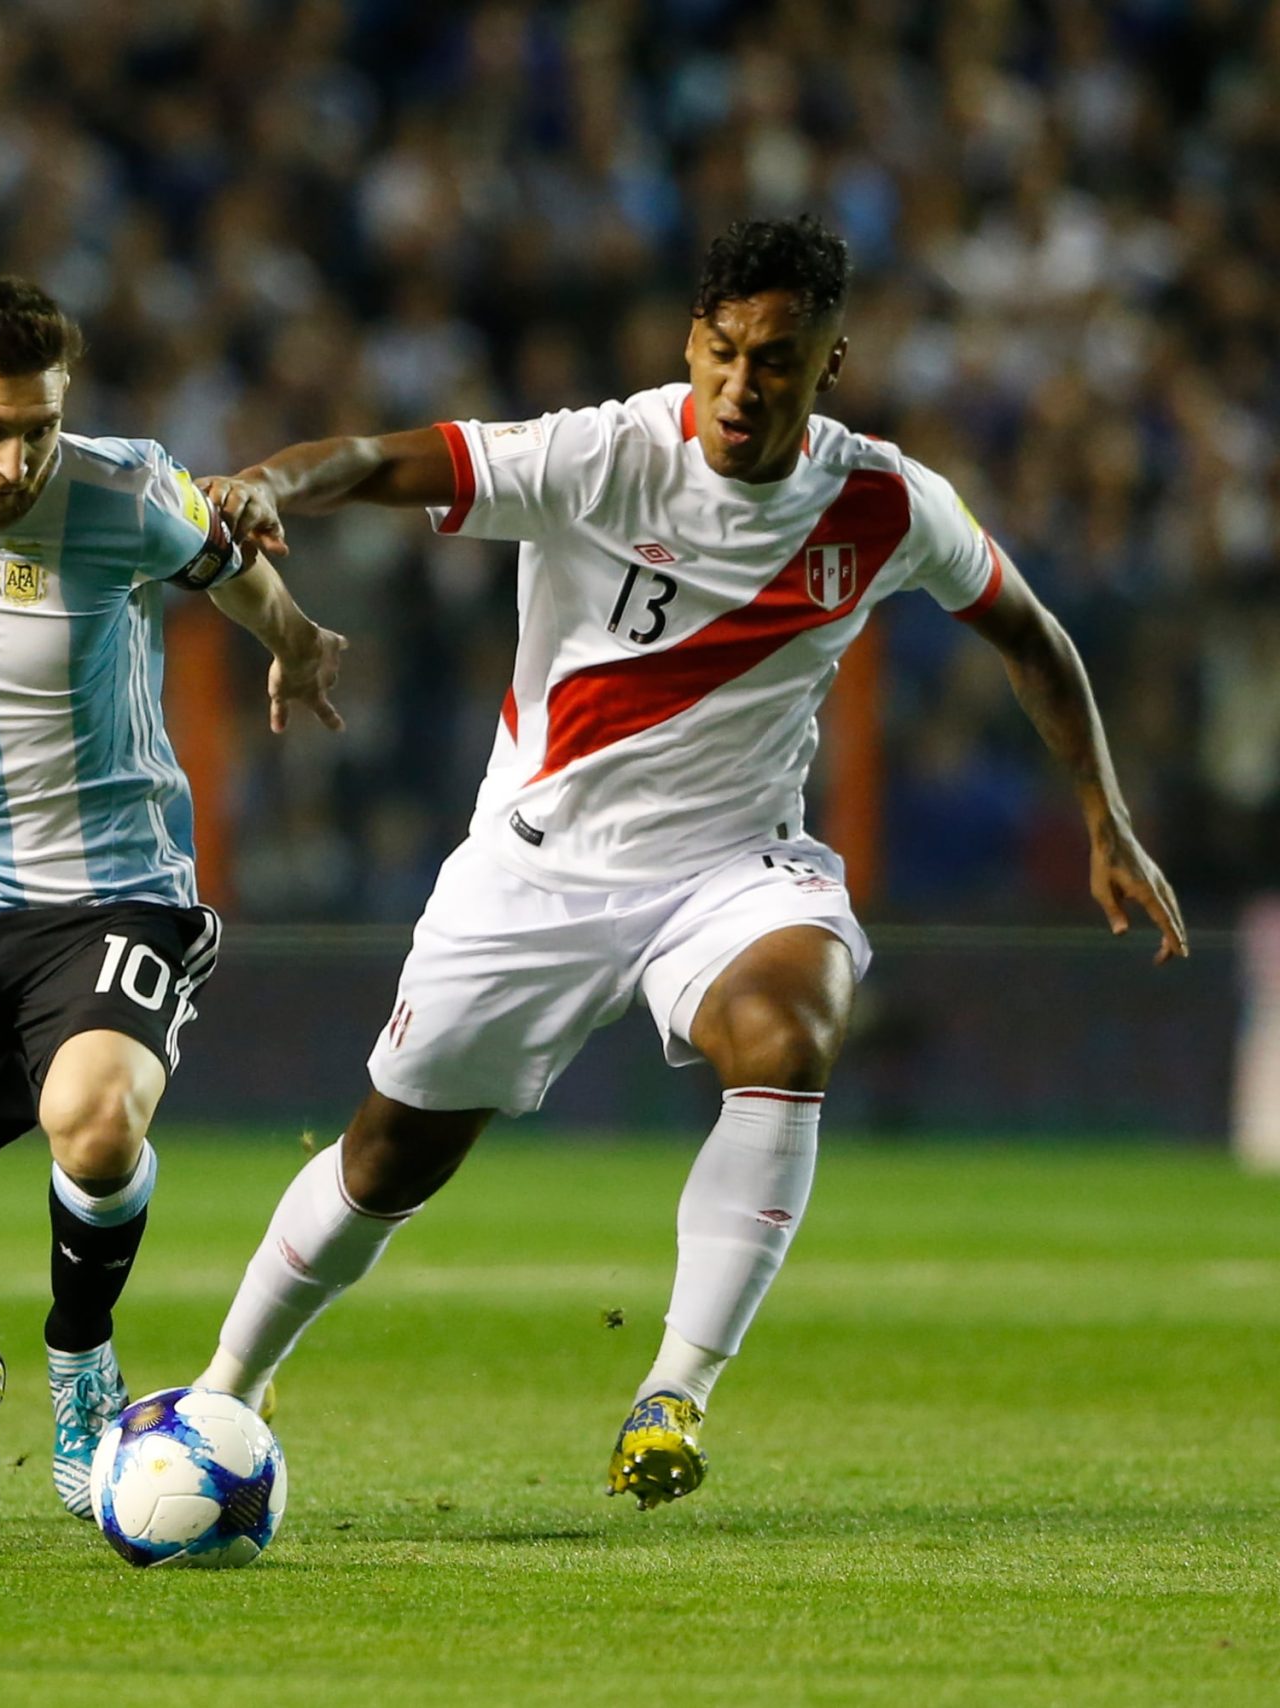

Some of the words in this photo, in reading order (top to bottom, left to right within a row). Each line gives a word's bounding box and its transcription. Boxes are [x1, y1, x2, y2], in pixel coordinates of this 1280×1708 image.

[7, 564, 34, 593] AFA
[813, 566, 850, 580] FPF
[608, 563, 678, 645] 13
[94, 933, 171, 1011] 10
